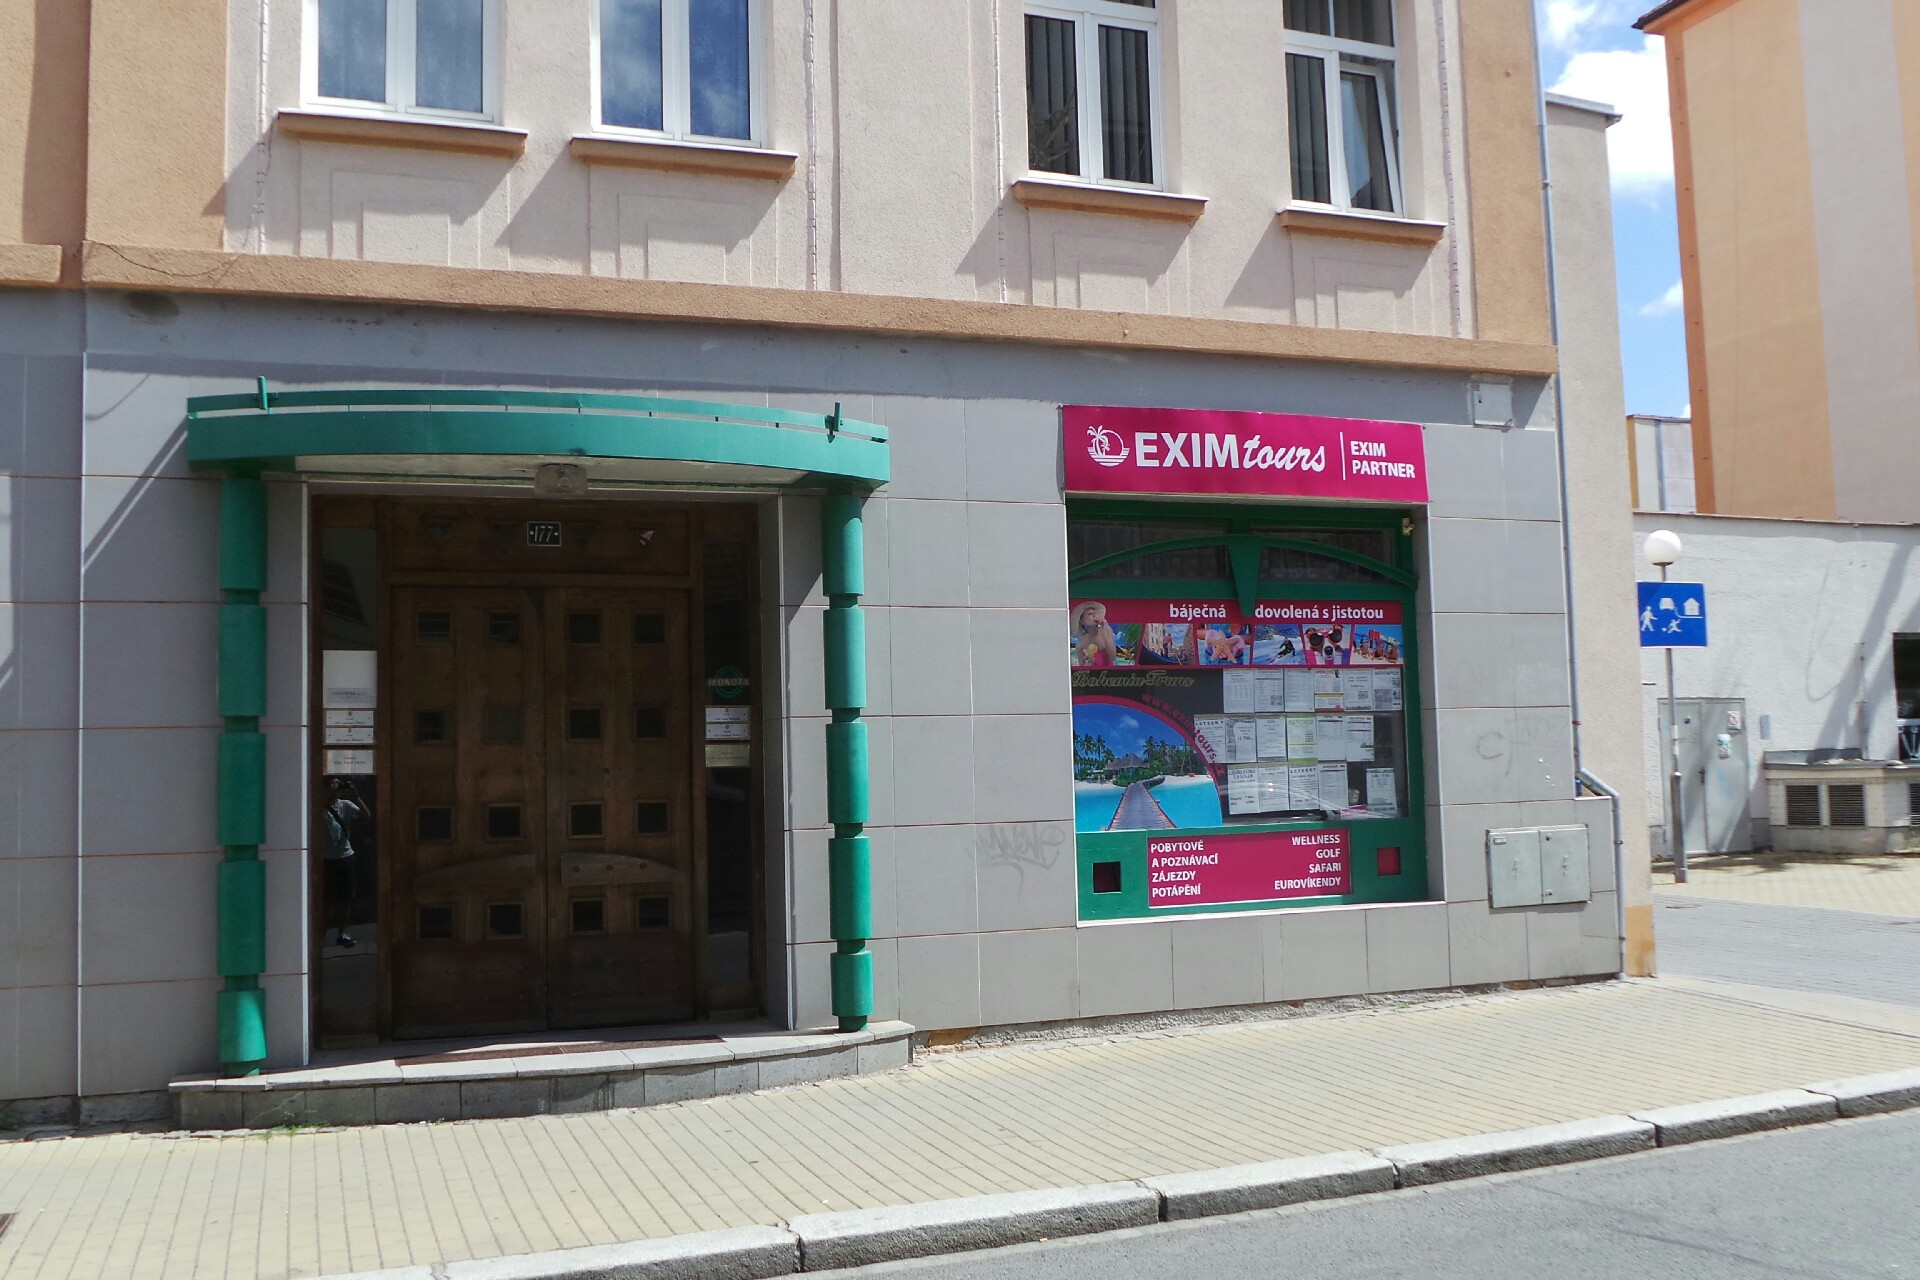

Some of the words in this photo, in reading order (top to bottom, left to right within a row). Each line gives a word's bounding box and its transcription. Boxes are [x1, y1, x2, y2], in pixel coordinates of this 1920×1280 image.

[1350, 440, 1386, 458] EXIM
[1352, 461, 1416, 479] PARTNER
[534, 525, 554, 543] 177
[1169, 603, 1227, 621] báječná
[1254, 604, 1320, 619] dovolená
[1322, 607, 1329, 619] s
[1331, 605, 1384, 622] jistotou
[1150, 839, 1204, 854] POBYTOVÉ
[1291, 834, 1341, 846] WELLNESS
[1151, 858, 1160, 868] A
[1161, 853, 1219, 867] POZNÁVACÍ
[1315, 848, 1341, 859] GOLF
[1308, 862, 1342, 874] SAFARI
[1151, 870, 1197, 883] ZÁJEZDY
[1274, 876, 1342, 890] EUROVÍKENDY
[1152, 883, 1202, 898] POTÁPĚNÍ
